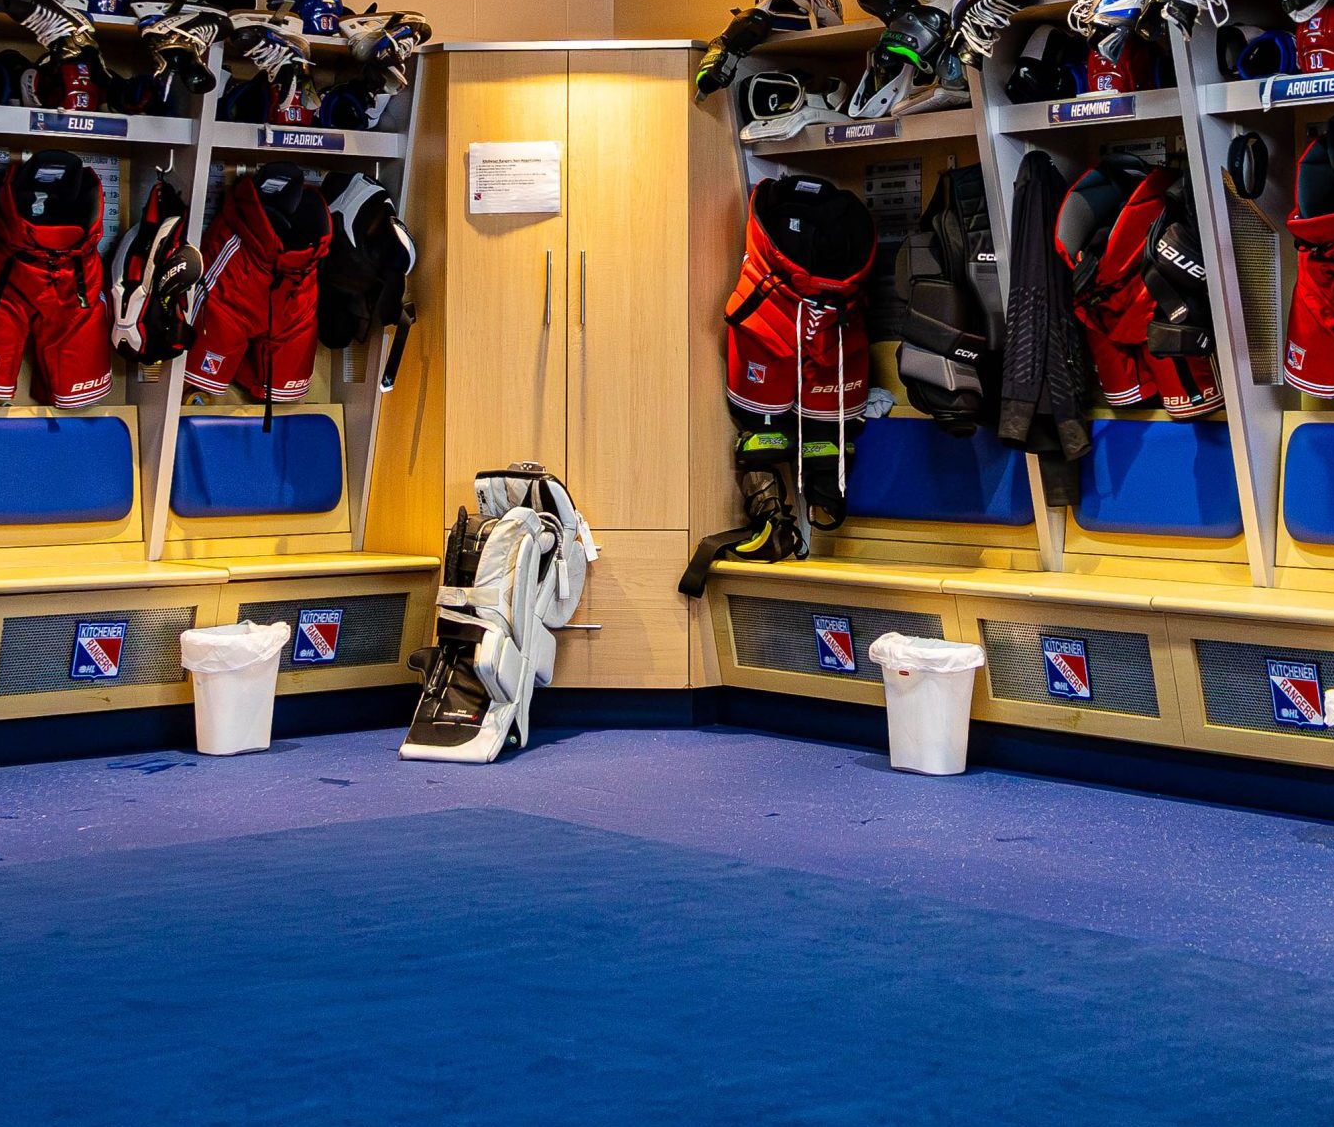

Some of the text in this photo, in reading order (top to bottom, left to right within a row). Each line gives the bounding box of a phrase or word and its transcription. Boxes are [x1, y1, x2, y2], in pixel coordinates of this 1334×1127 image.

[1310, 53, 1323, 69] 11
[1097, 75, 1113, 90] 82
[1071, 100, 1111, 118] HEMMING
[68, 117, 94, 131] ELLIS
[845, 124, 876, 138] HRICZOV
[283, 132, 324, 147] HEADRICK
[977, 253, 997, 262] CC
[955, 348, 979, 361] CCM
[810, 379, 863, 394] BAUER
[301, 611, 340, 624] KITCHENER
[816, 618, 849, 632] KITCHENER
[81, 625, 123, 638] KITCHENER
[305, 624, 331, 657] RANGERS
[822, 630, 850, 666] RANGERS
[1044, 639, 1082, 656] KITCHENER
[85, 638, 114, 673] RANGERS
[1051, 653, 1083, 694] RANGERS
[1270, 662, 1314, 680] KITCHENER
[1279, 678, 1317, 721] RANGERS
